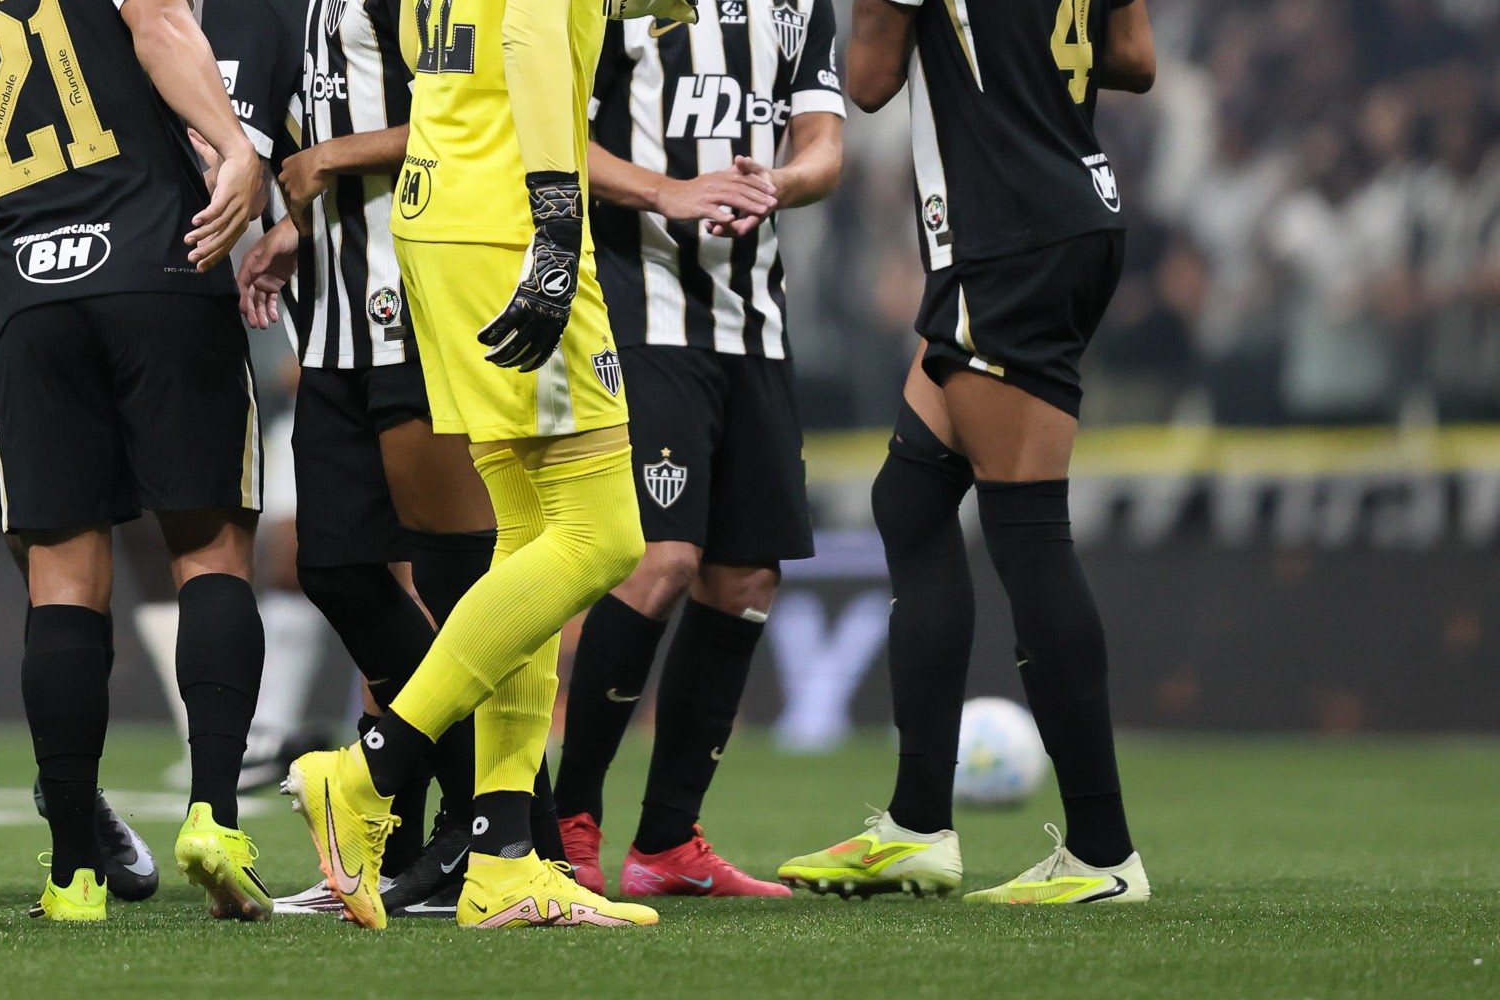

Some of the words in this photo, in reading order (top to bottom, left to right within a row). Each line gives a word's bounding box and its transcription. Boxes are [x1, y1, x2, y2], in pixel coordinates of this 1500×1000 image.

[774, 12, 802, 26] CAM
[59, 49, 83, 107] mundiale
[13, 222, 111, 247] SUPERMERCADOS
[28, 237, 92, 276] BH
[650, 468, 682, 478] CAM
